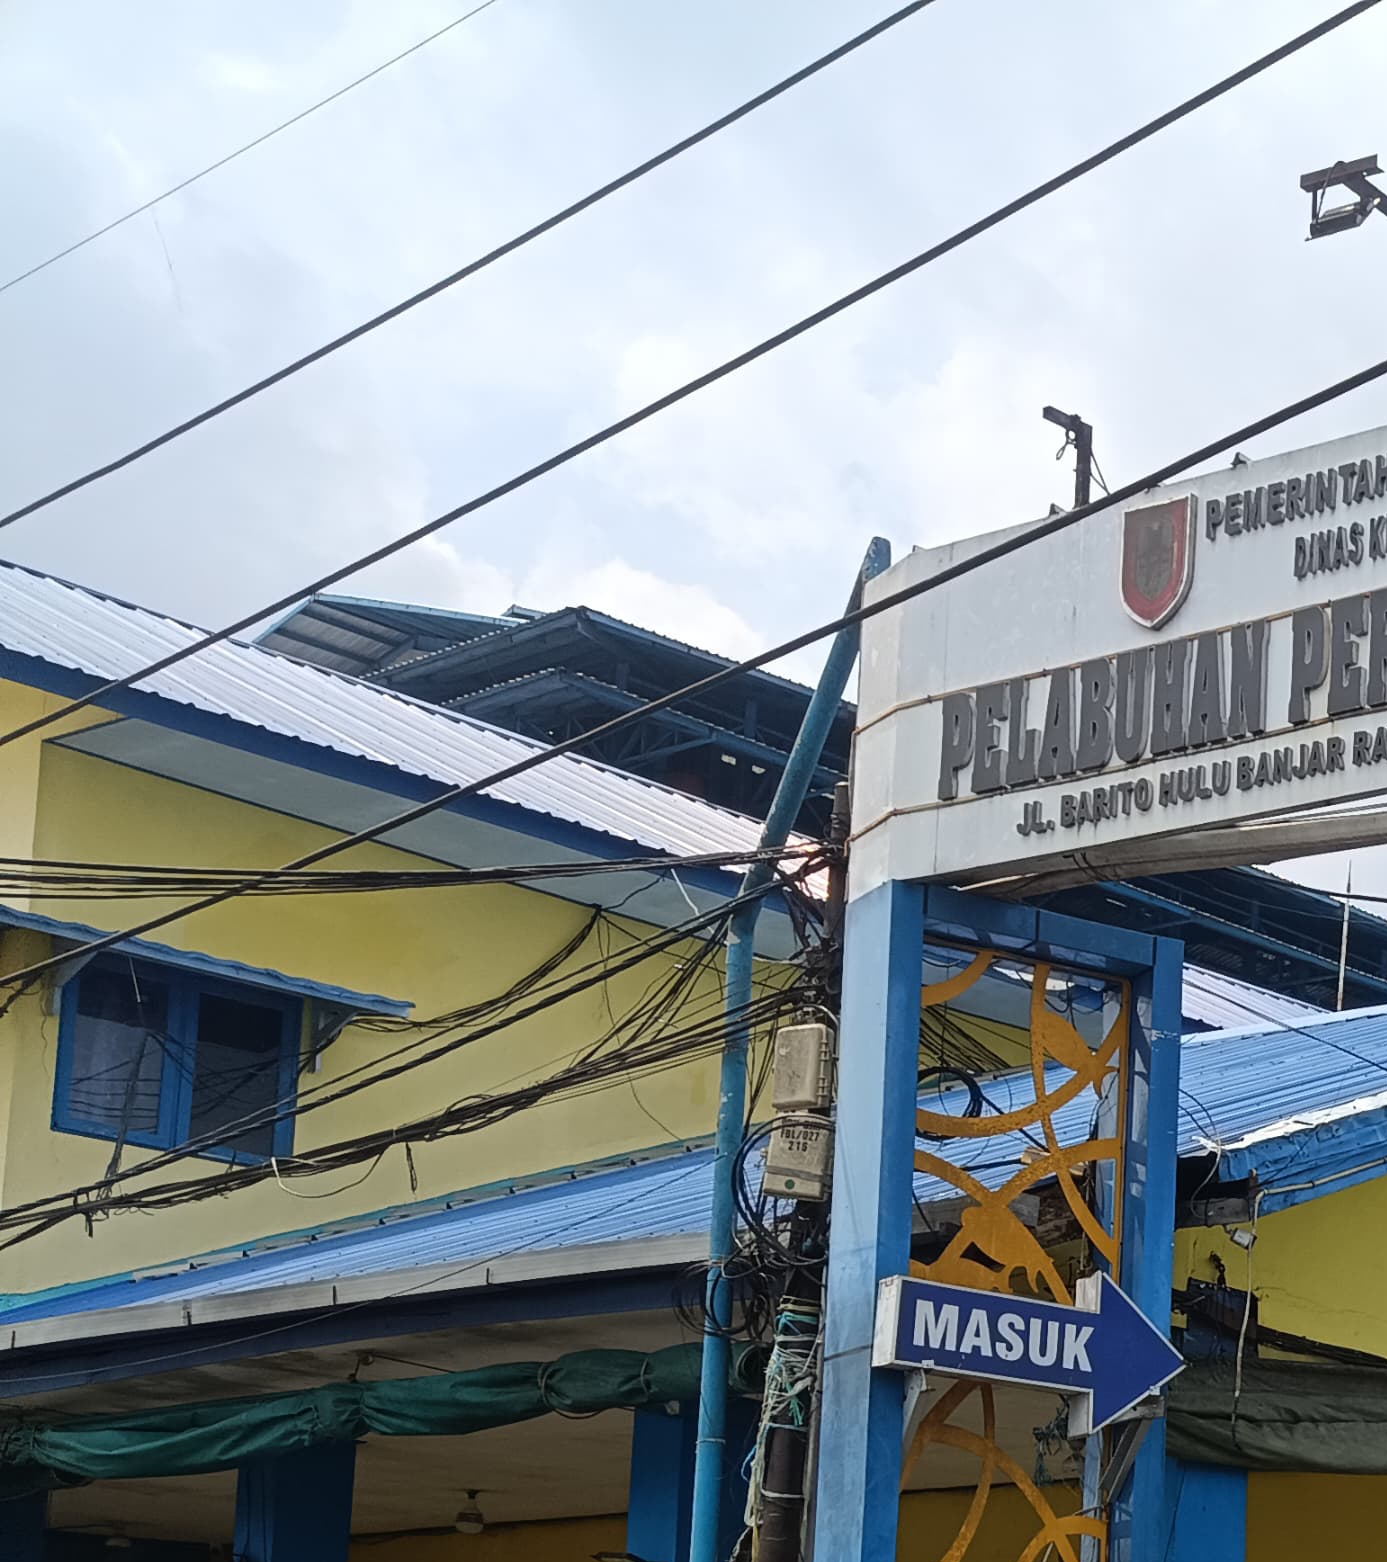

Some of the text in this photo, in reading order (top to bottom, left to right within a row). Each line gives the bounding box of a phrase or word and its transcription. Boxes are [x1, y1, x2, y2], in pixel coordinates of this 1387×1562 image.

[1293, 521, 1366, 582] DINAS
[937, 618, 1270, 802] PELABUHAN
[1016, 801, 1056, 838] JL.
[1060, 776, 1155, 830] BARITO
[1158, 760, 1231, 808] HULU
[1236, 735, 1345, 792] BANJAR
[912, 1298, 1095, 1373] MASUK
